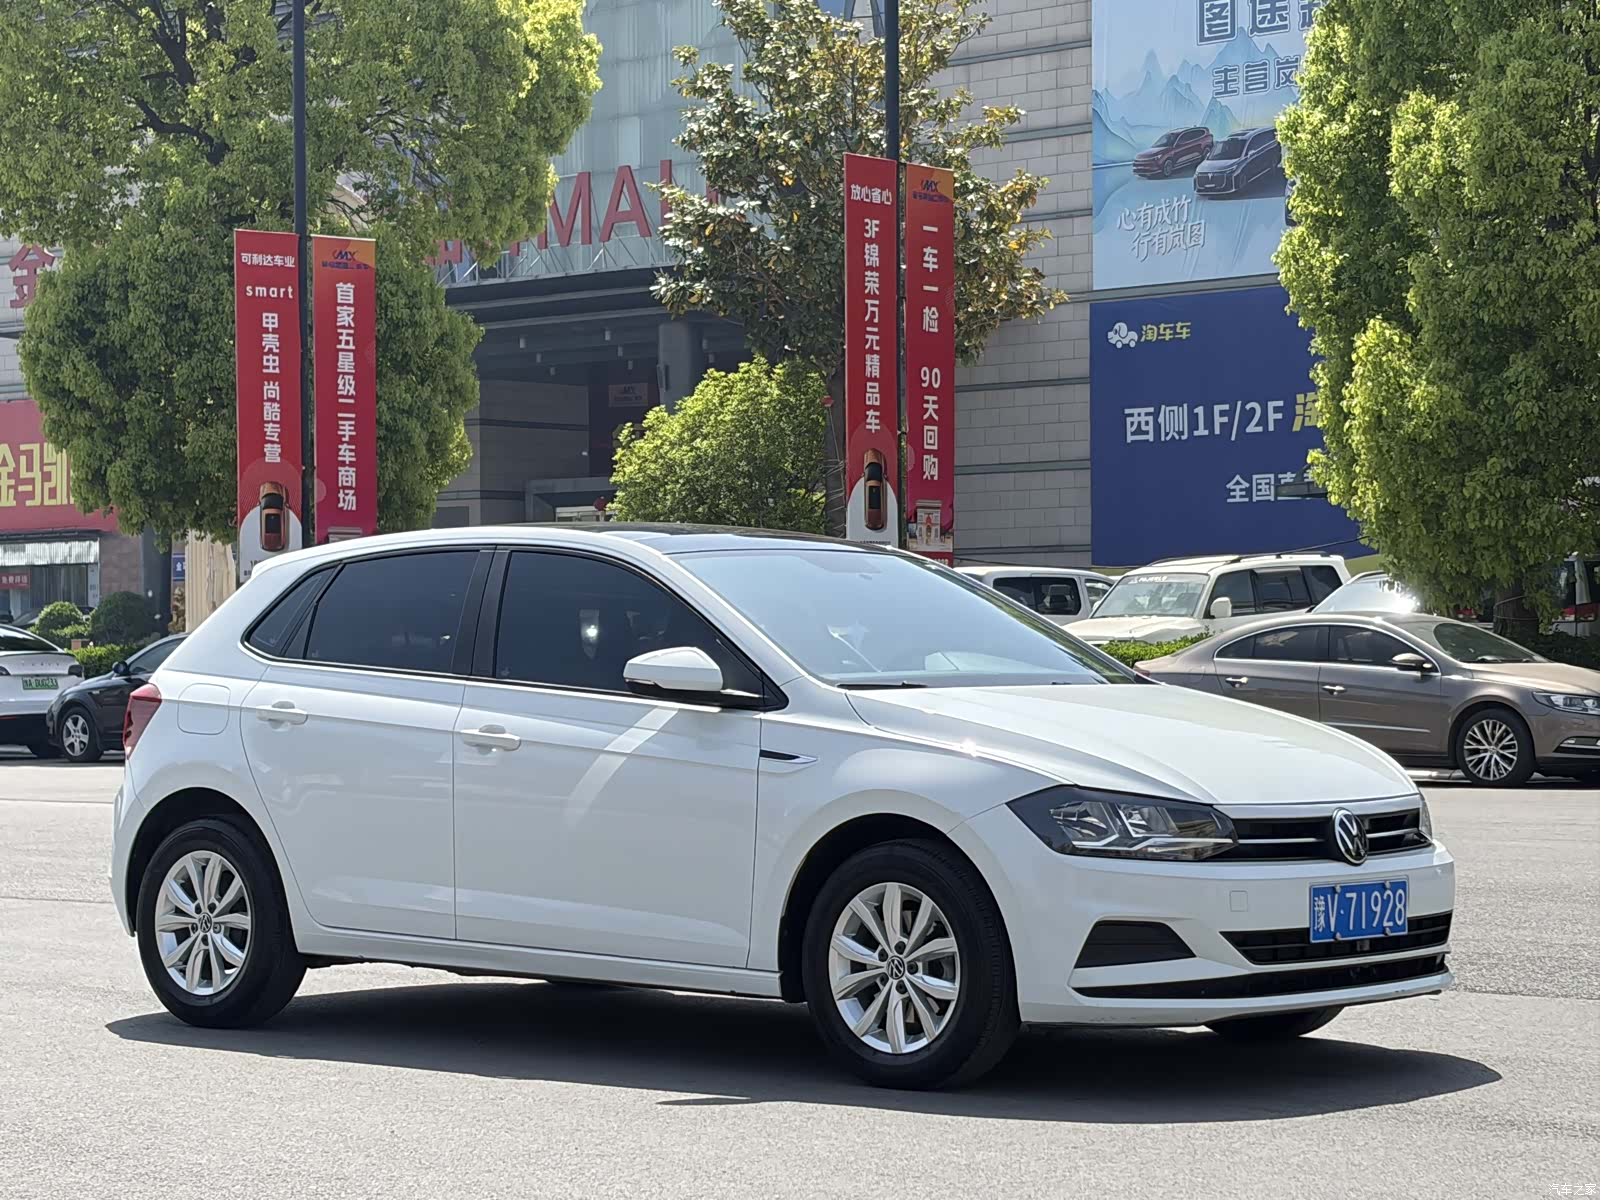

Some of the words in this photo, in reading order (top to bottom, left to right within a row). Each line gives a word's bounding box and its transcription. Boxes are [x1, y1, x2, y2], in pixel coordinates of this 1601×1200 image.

[851, 184, 892, 205] 放心省心
[1116, 195, 1192, 232] 心有成竹
[240, 252, 296, 268] 可利达车业
[1131, 219, 1206, 263] 行有岚图
[245, 285, 294, 299] smart
[923, 225, 939, 333] 一车一检
[261, 312, 281, 374] 甲壳虫
[864, 218, 880, 433] 3F锦荣万元精品车
[1140, 321, 1192, 343] 淘车车
[336, 282, 357, 511] 首家五星级二手车商场
[263, 380, 282, 463] 尚酷专营
[921, 366, 941, 481] 90天回购
[1123, 400, 1285, 444] 西侧1F/2F
[0, 442, 75, 506] 金马凯
[1226, 472, 1318, 503] 全国
